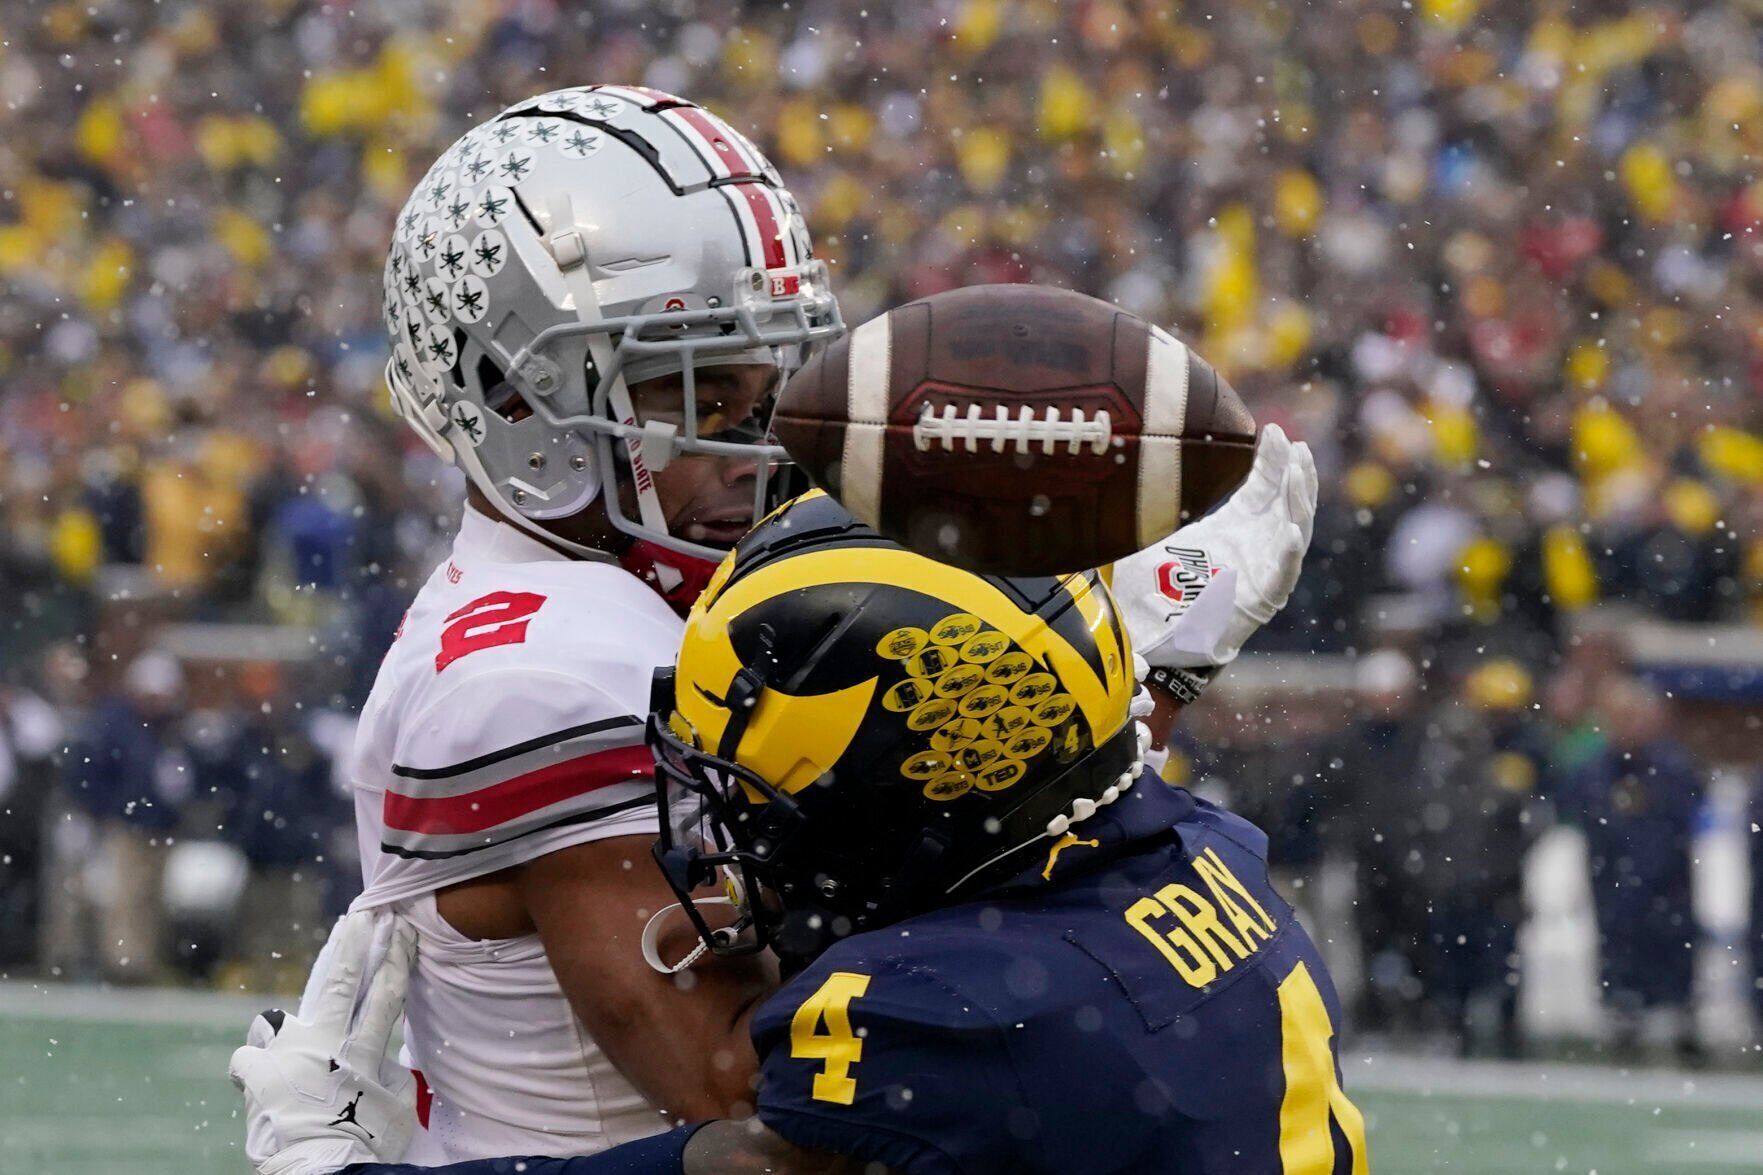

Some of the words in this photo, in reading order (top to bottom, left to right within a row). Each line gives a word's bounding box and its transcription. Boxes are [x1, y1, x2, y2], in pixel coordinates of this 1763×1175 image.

[435, 590, 548, 675] 2
[1124, 846, 1278, 989] GRAY
[789, 971, 872, 1106] 4
